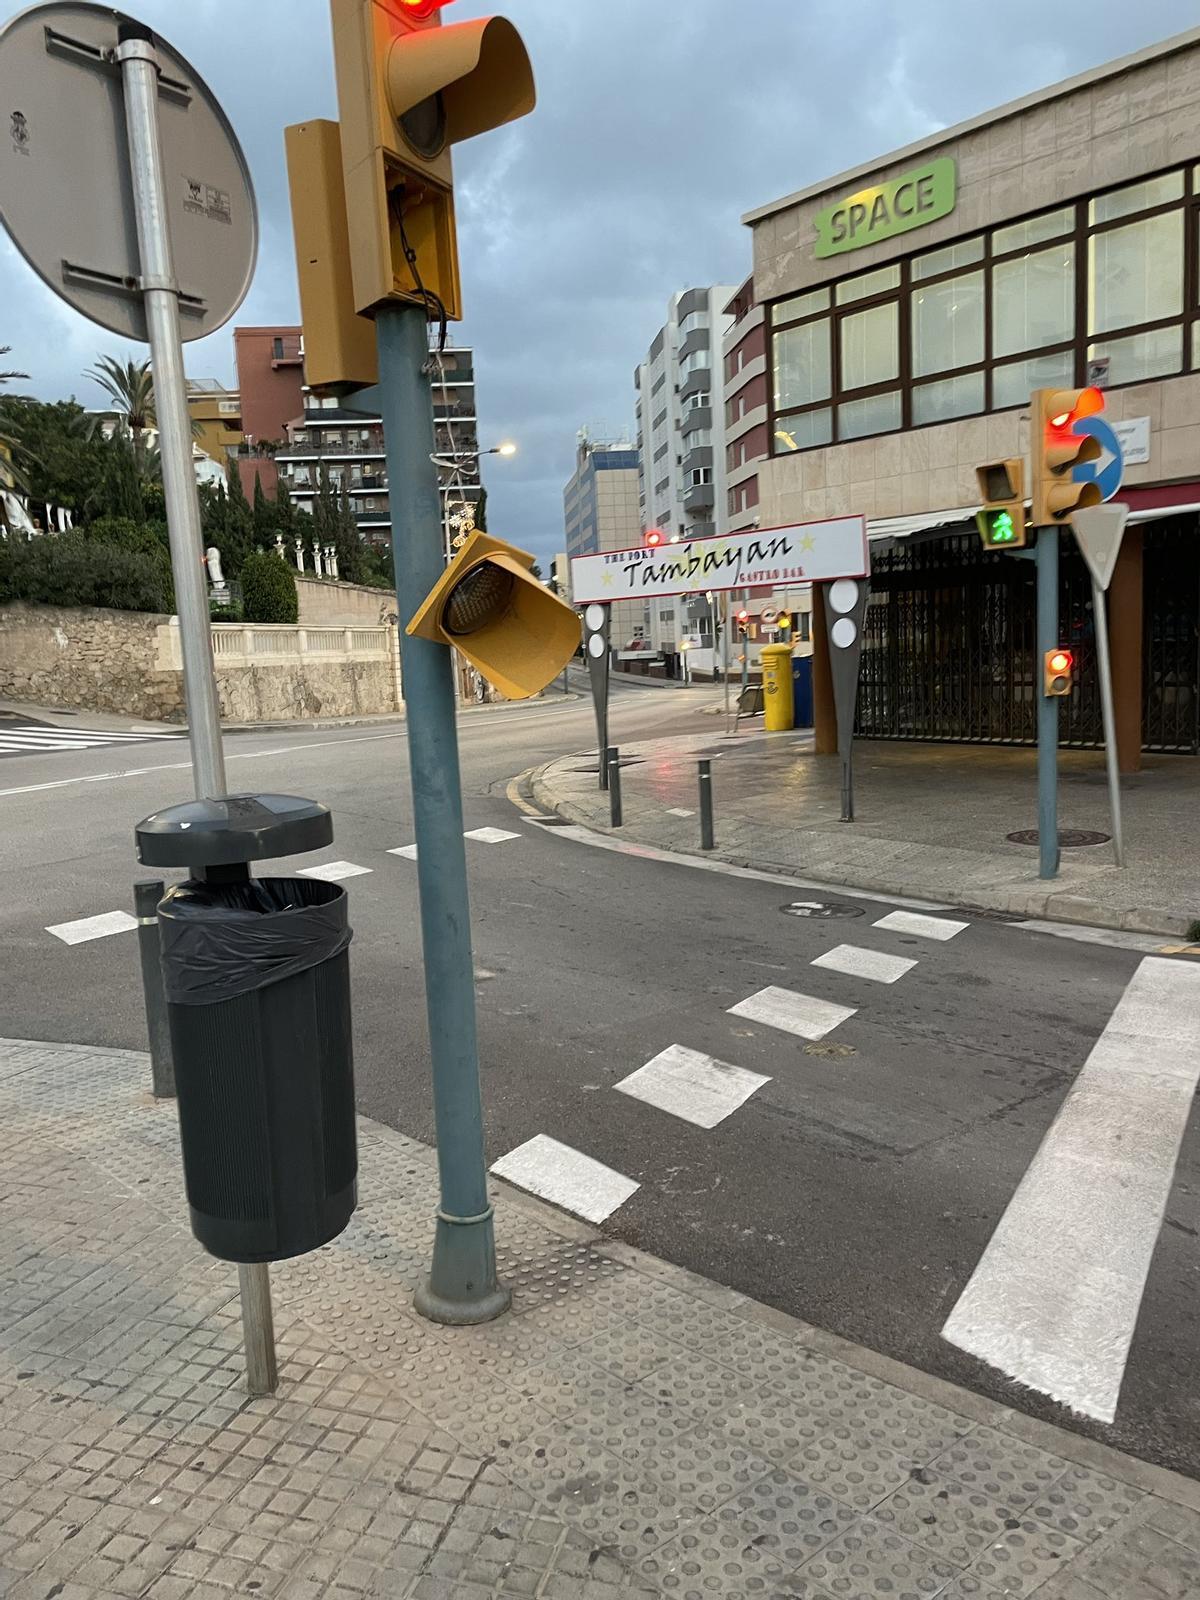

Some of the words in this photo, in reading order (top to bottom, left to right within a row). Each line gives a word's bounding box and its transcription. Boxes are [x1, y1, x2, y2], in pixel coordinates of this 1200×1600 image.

[830, 173, 934, 245] SPACE
[604, 553, 624, 564] THE
[628, 548, 655, 561] PORT
[623, 536, 793, 587] Tambayan
[740, 569, 779, 582] GASTRO
